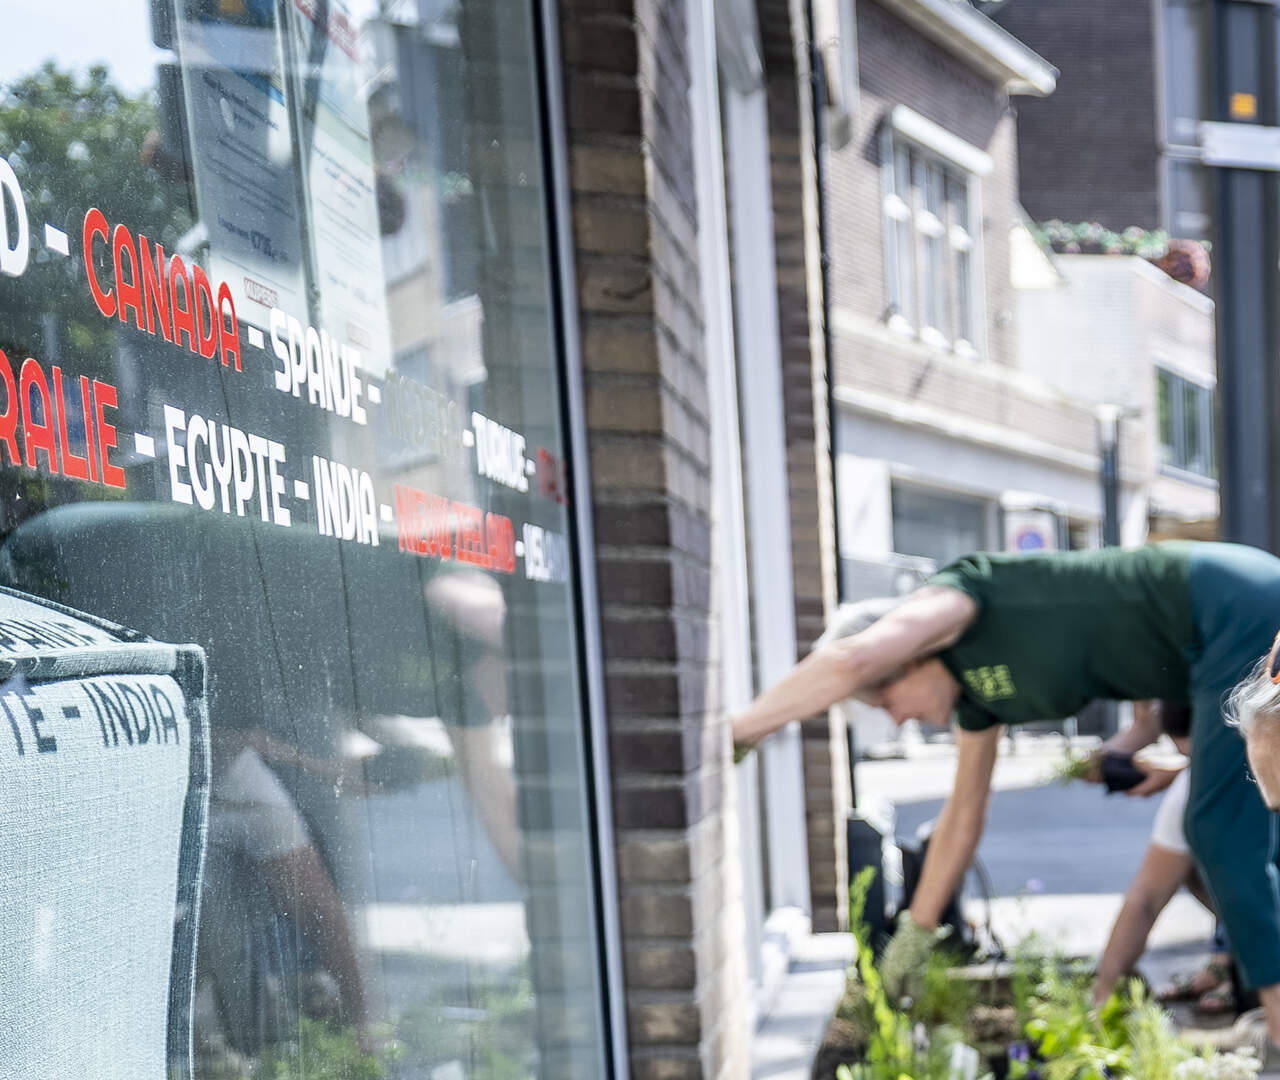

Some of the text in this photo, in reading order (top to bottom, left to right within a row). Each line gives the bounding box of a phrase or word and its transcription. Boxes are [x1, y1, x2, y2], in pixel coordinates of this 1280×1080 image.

[83, 207, 242, 372] CANADA
[270, 307, 367, 426] SPANJE
[164, 404, 291, 527] EGYPTE
[312, 455, 380, 546] INDIA
[80, 681, 180, 747] INDIA
